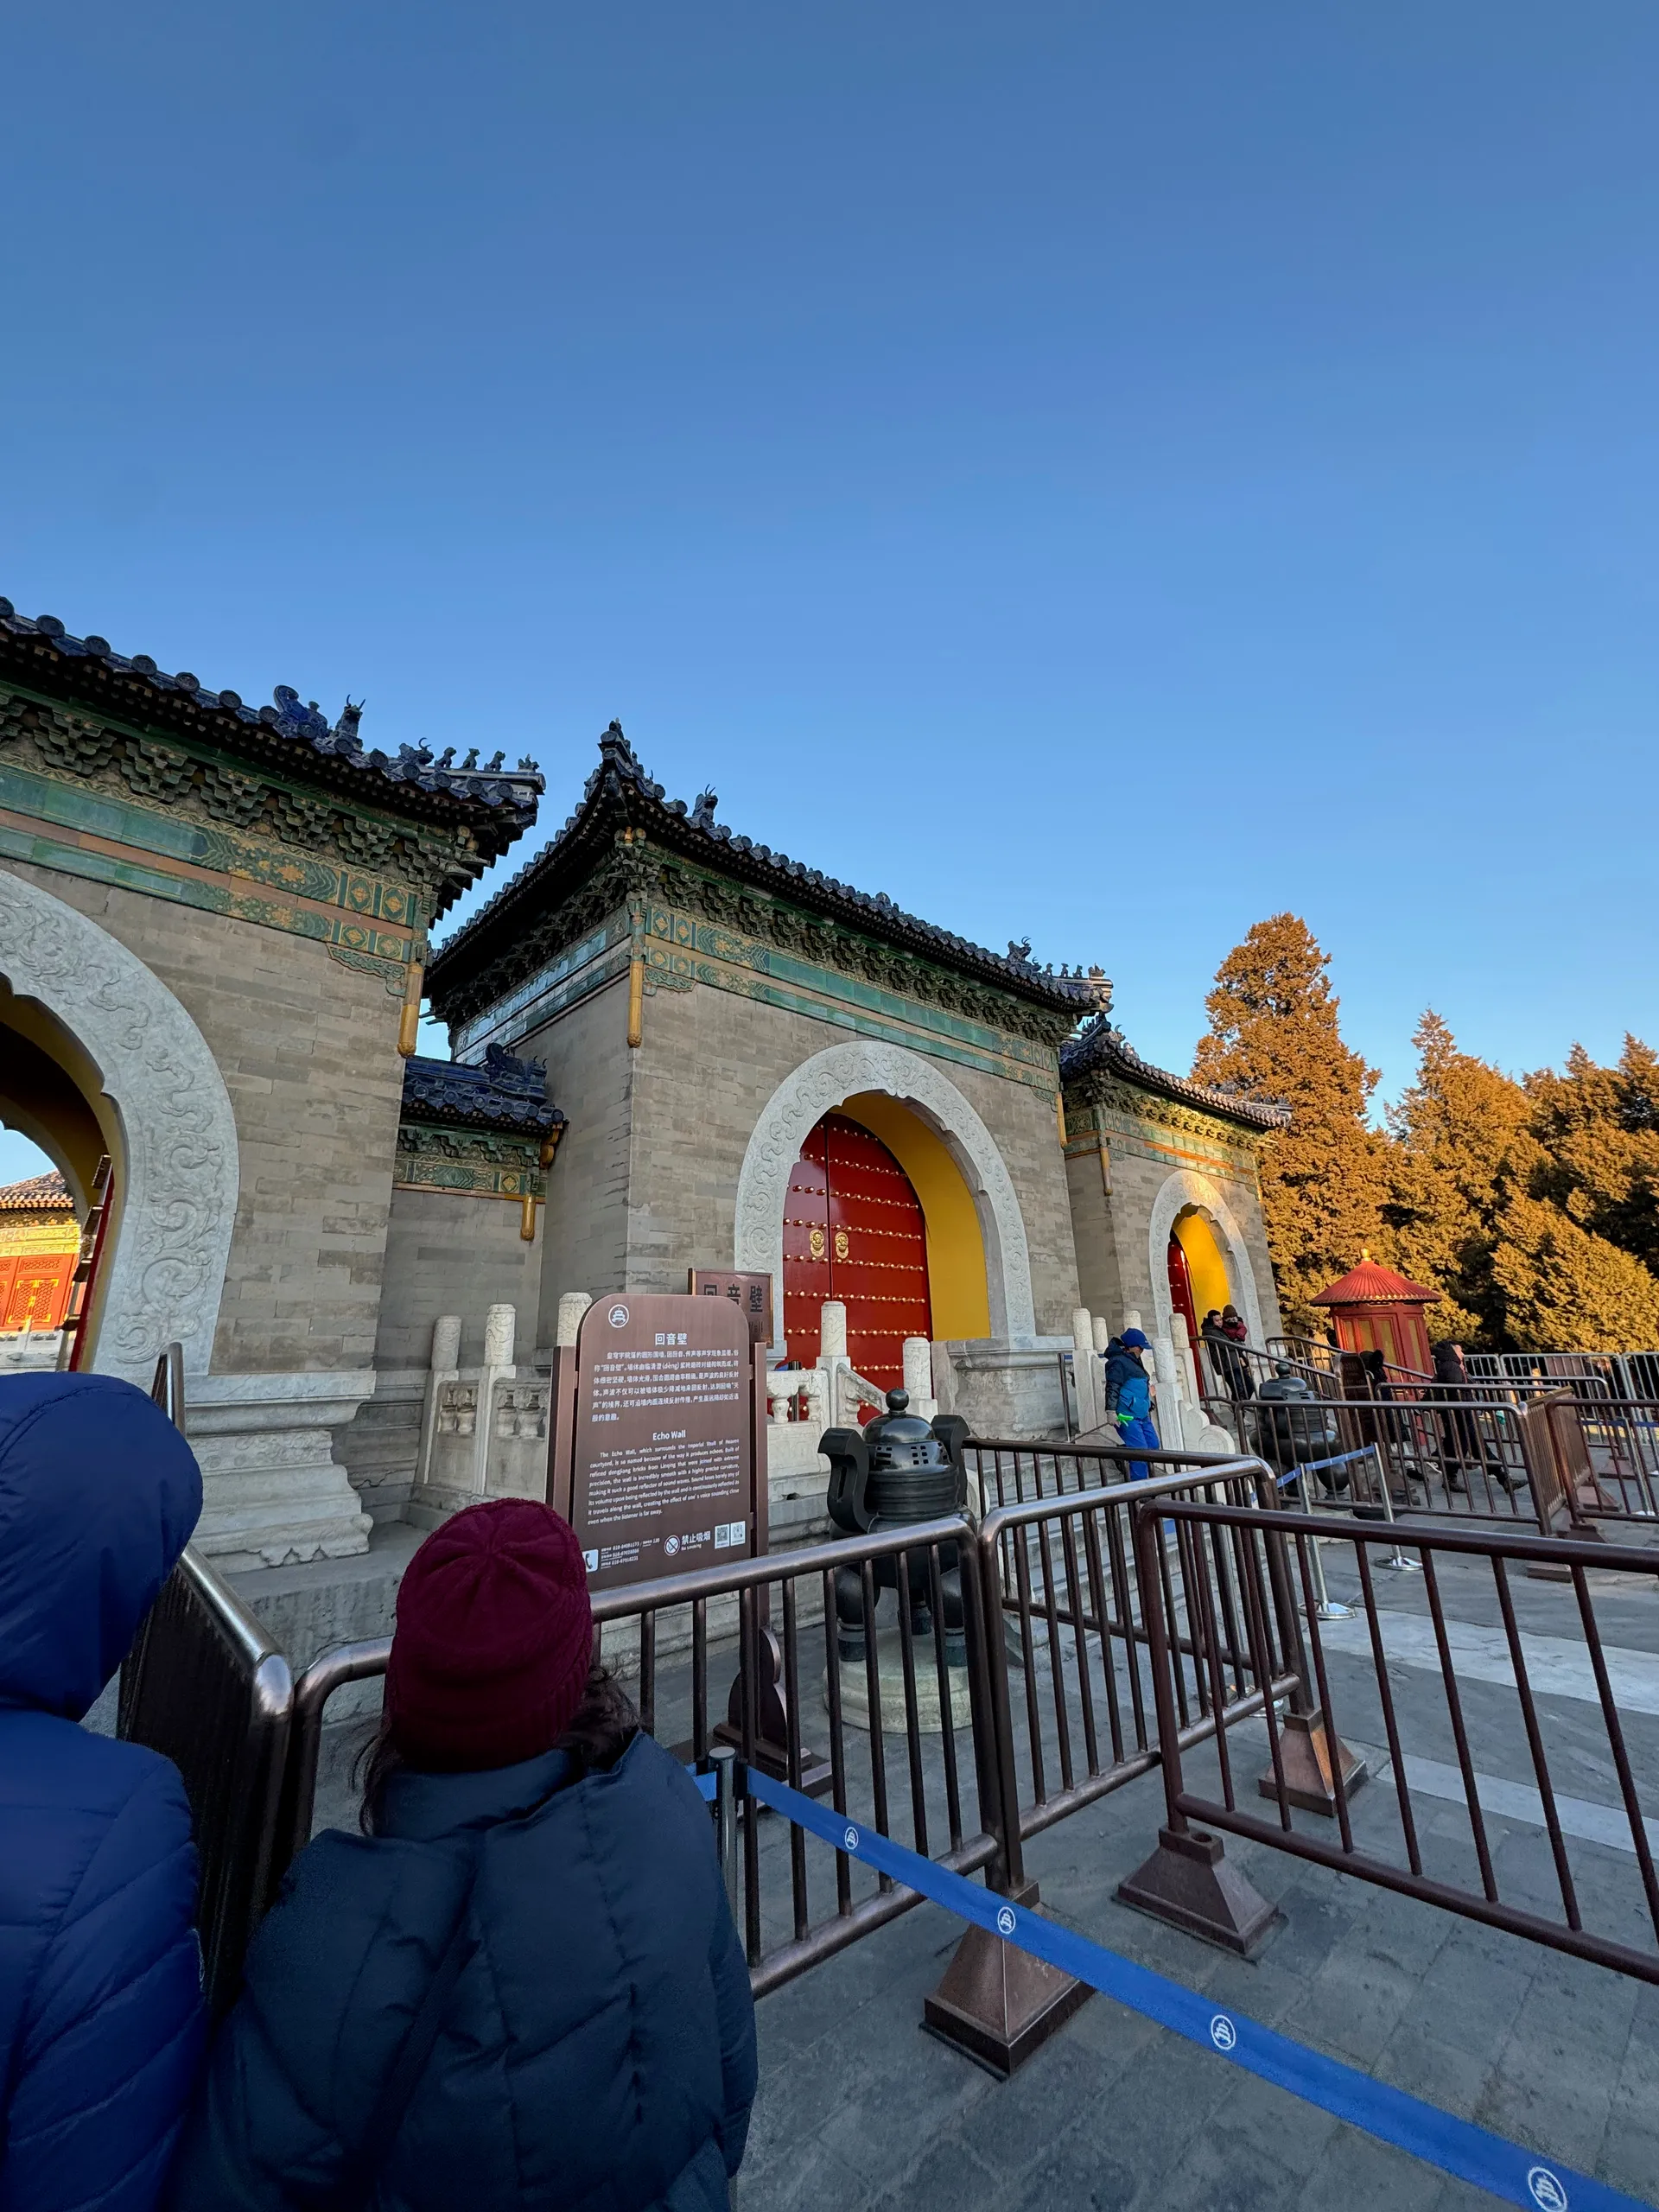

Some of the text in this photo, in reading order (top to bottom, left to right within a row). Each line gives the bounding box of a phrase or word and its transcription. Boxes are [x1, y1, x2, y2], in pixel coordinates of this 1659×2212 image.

[655, 1333, 687, 1345] 回音壁
[653, 1430, 686, 1441] Echo Wall
[589, 1479, 612, 1488] precision,
[681, 1531, 711, 1545] 禁止吸烟
